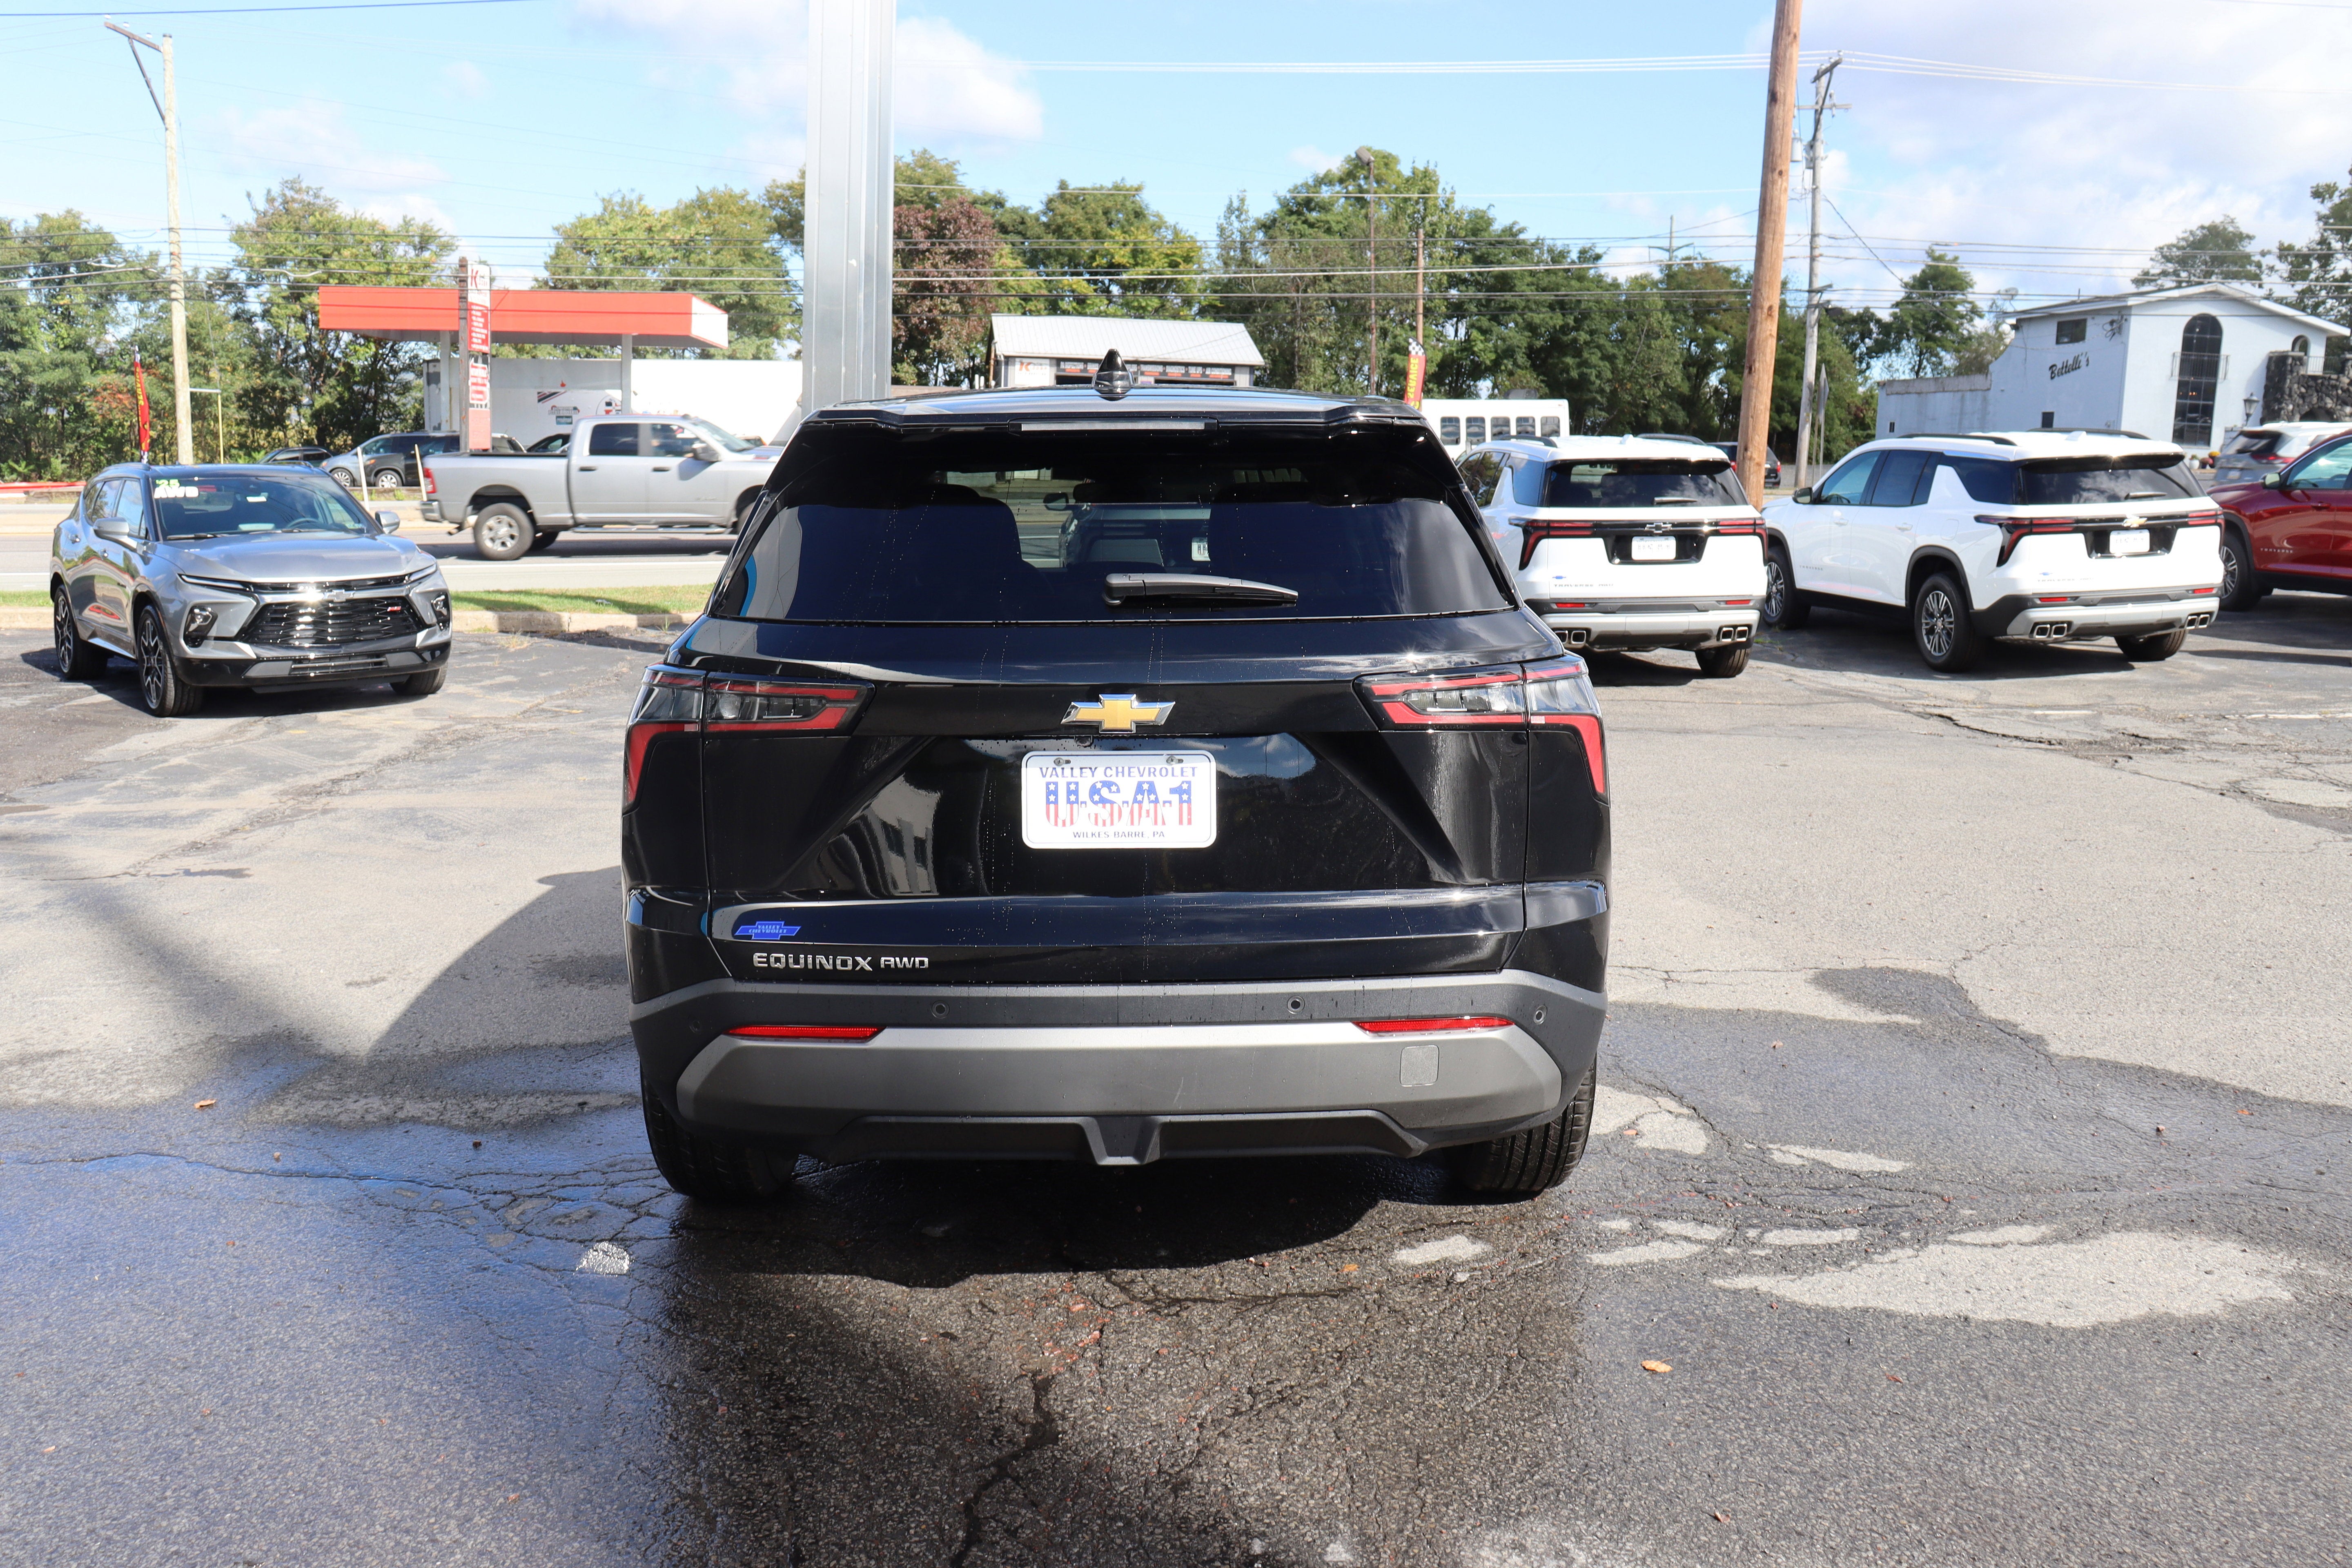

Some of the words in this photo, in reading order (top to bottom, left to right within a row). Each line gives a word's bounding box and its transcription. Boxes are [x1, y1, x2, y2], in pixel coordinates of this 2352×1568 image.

[154, 486, 199, 499] AWD
[1039, 766, 1098, 778] VALLEY
[1104, 766, 1198, 777] CHEVROLET
[753, 952, 873, 971] EQUINOX
[880, 957, 929, 969] AWD
